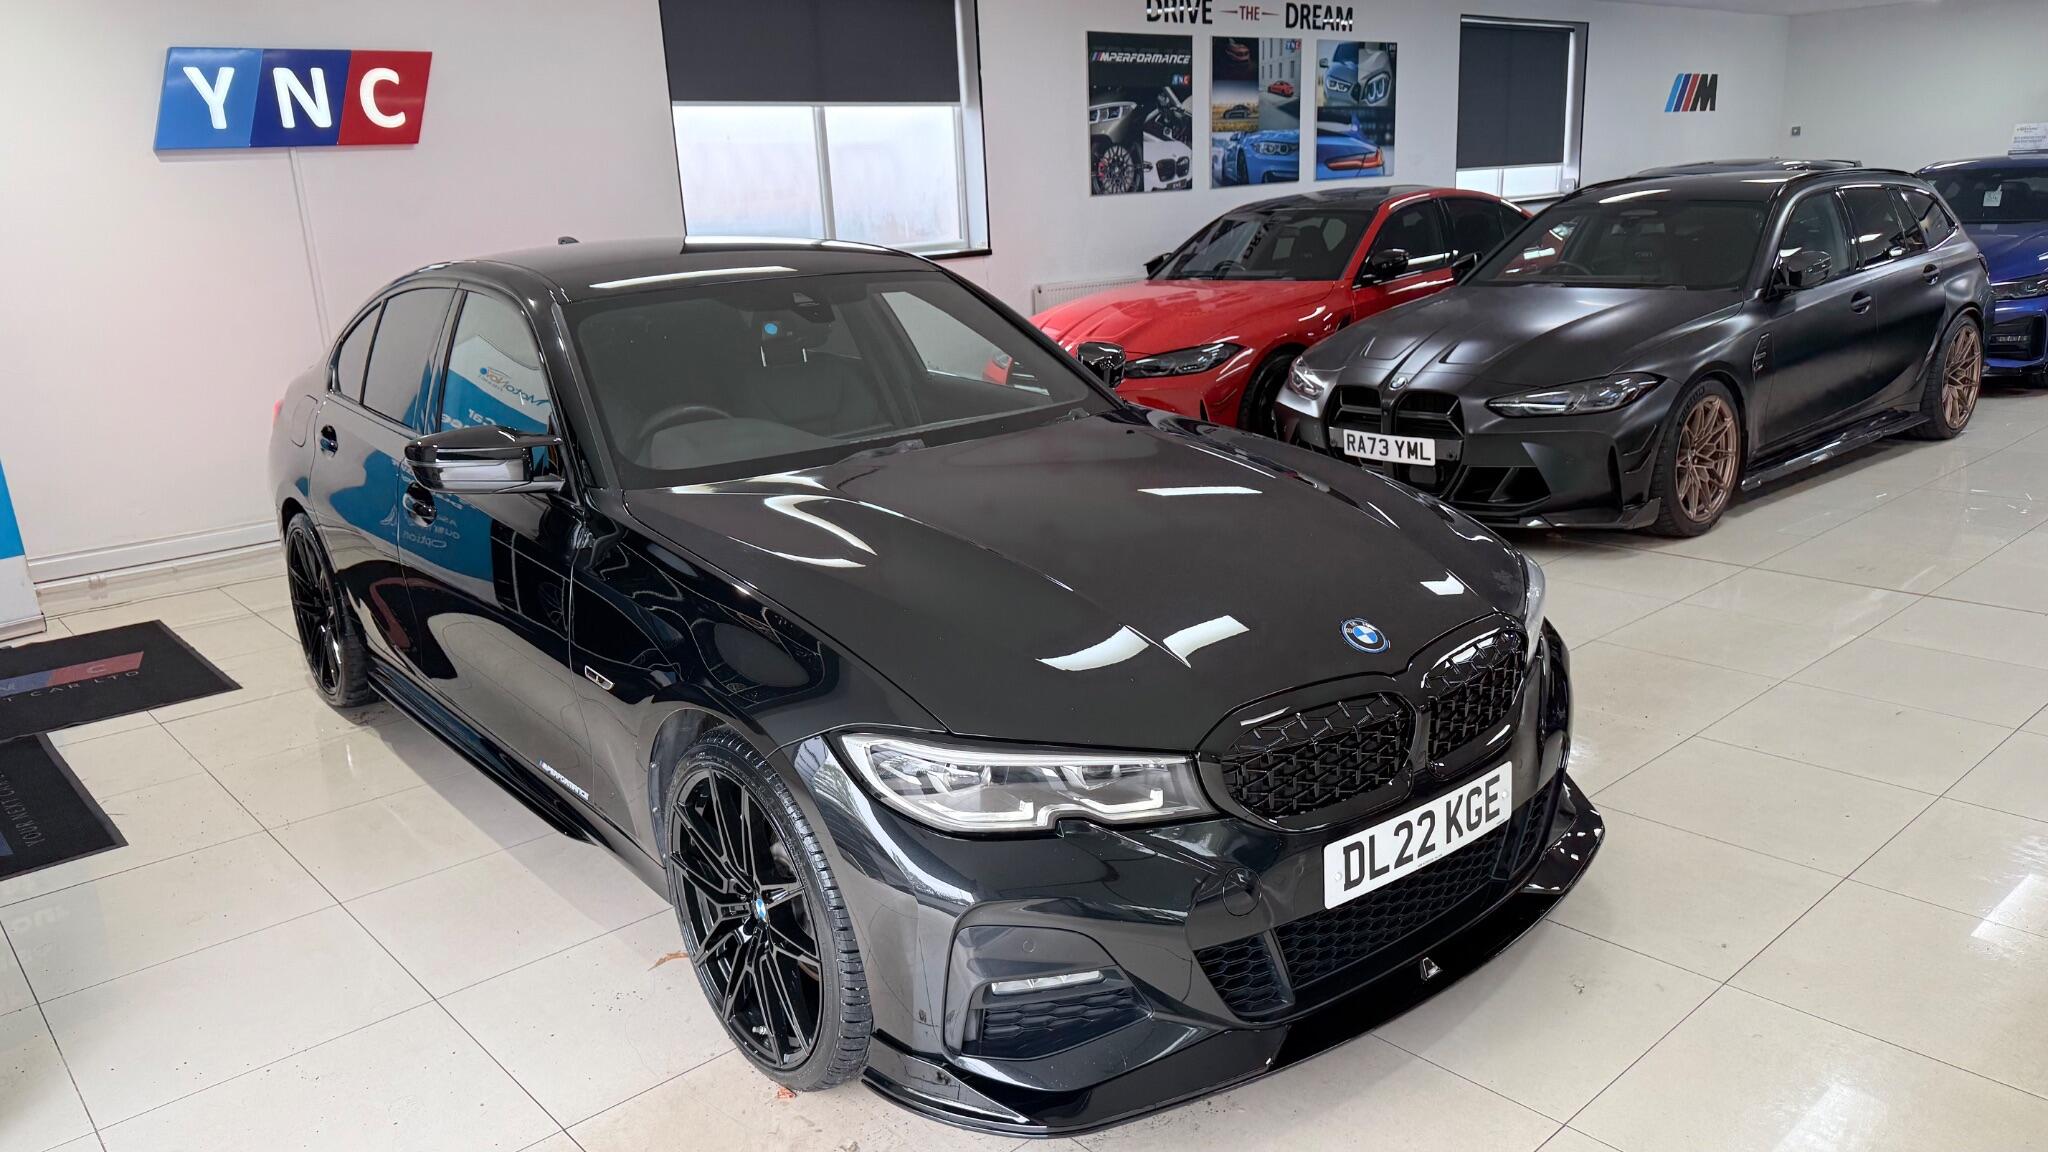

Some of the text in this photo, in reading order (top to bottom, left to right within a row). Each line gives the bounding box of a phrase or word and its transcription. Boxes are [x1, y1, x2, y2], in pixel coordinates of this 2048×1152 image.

[1146, 0, 1353, 32] DRIVE THE DREAM
[183, 66, 406, 130] YNC
[1346, 433, 1432, 461] RA73 YML
[93, 671, 139, 683] LTD
[16, 820, 46, 848] YOUR
[1342, 774, 1501, 892] DL22 KGE
